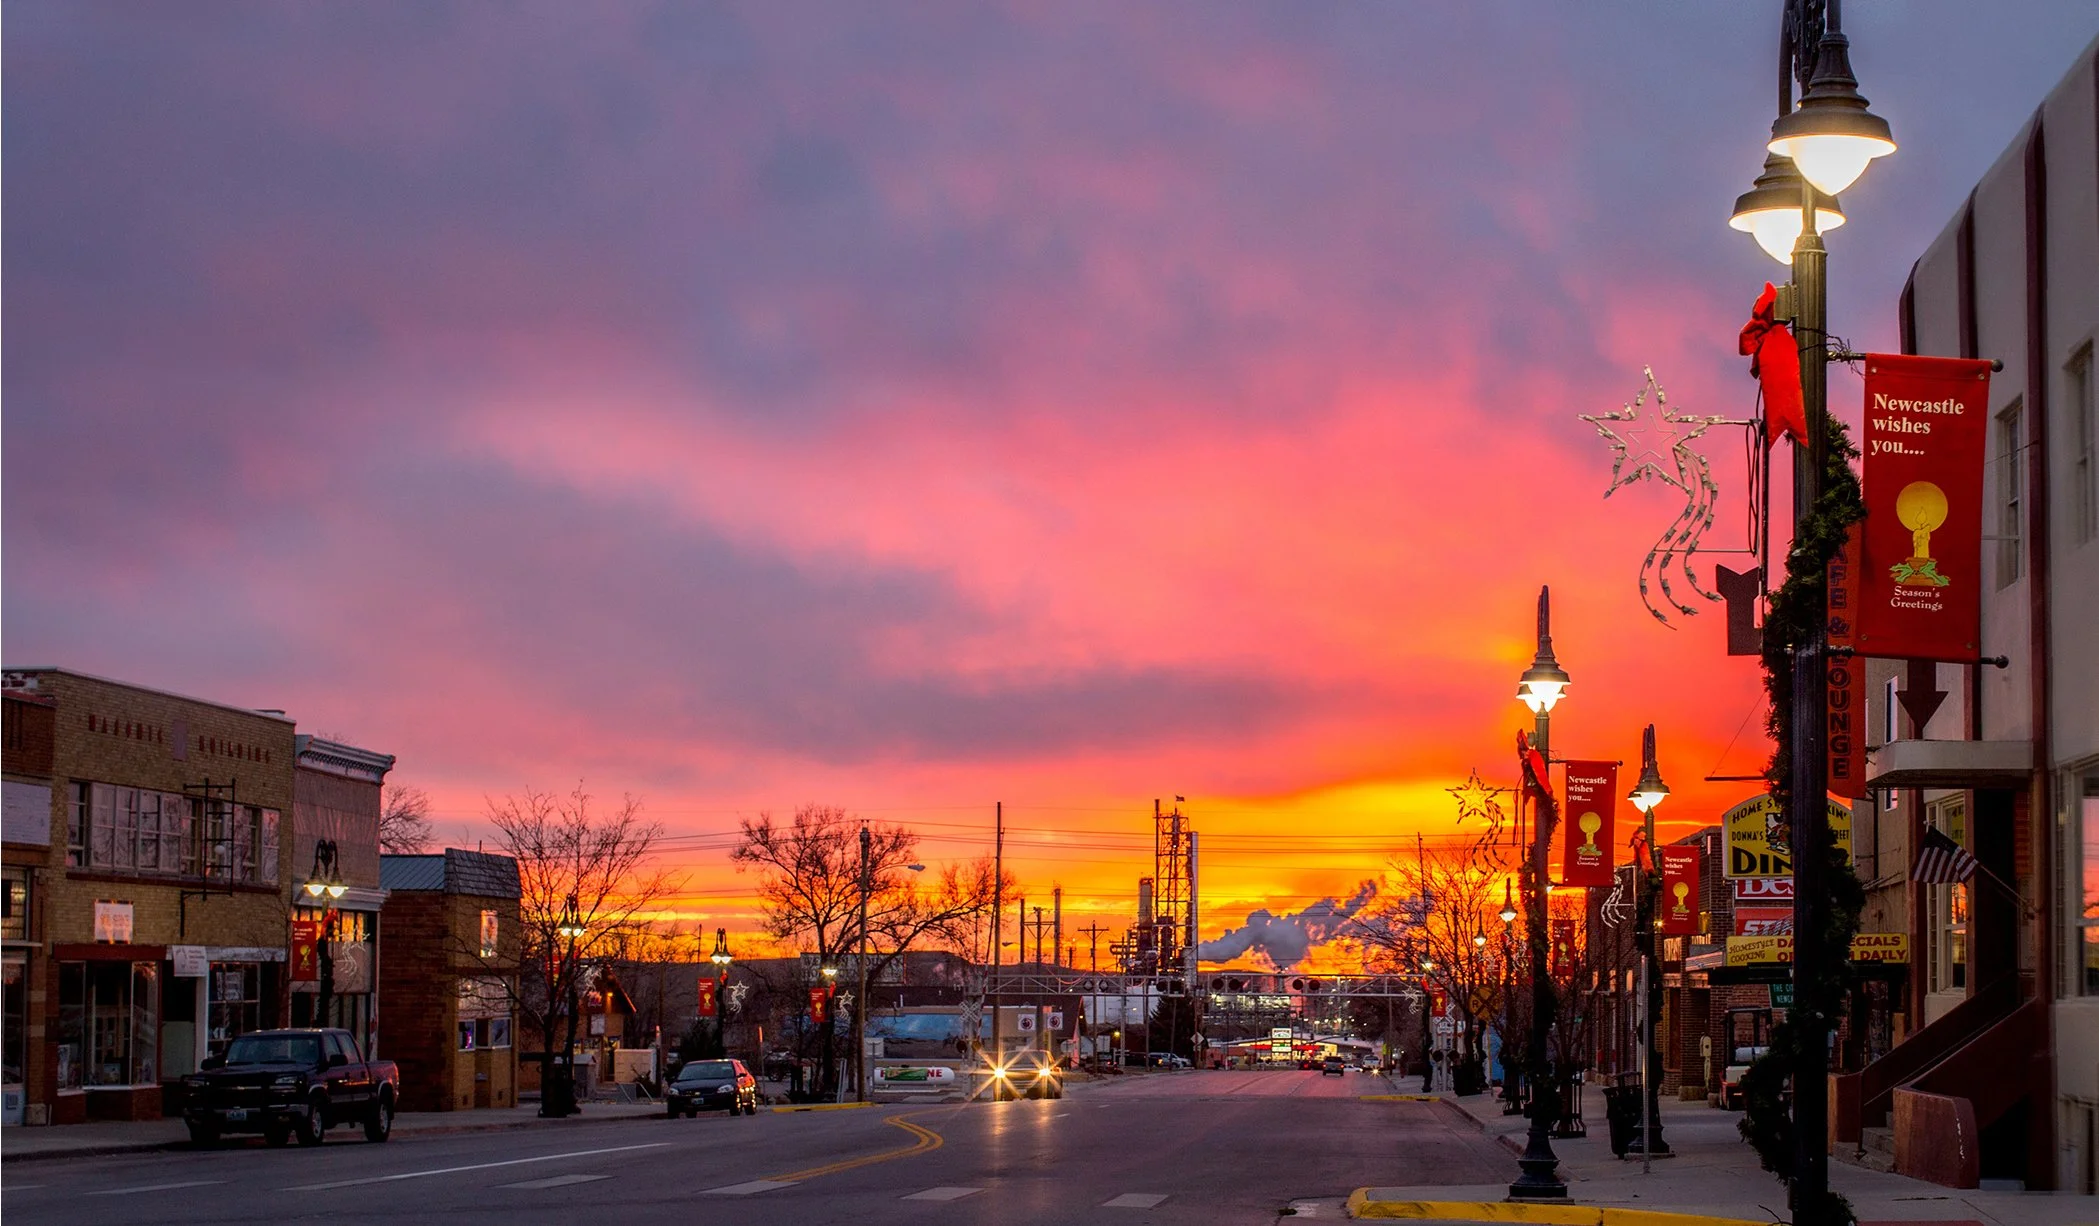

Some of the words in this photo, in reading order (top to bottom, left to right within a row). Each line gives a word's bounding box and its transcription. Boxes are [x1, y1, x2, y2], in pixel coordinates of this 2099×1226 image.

[1873, 393, 1964, 415] Newcastle
[1872, 416, 1931, 434] wishes
[1871, 439, 1925, 456] you....
[1894, 585, 1940, 598] Season's
[1890, 597, 1943, 611] Greetings
[1568, 775, 1607, 785] Newcastle
[1568, 784, 1594, 793] wishes
[1732, 801, 1762, 824] HOME
[1731, 830, 1763, 842] DONNA'S
[1732, 846, 1794, 874] DIN
[1729, 939, 1775, 954] HOMESTYLE
[1730, 950, 1766, 963] COOKING
